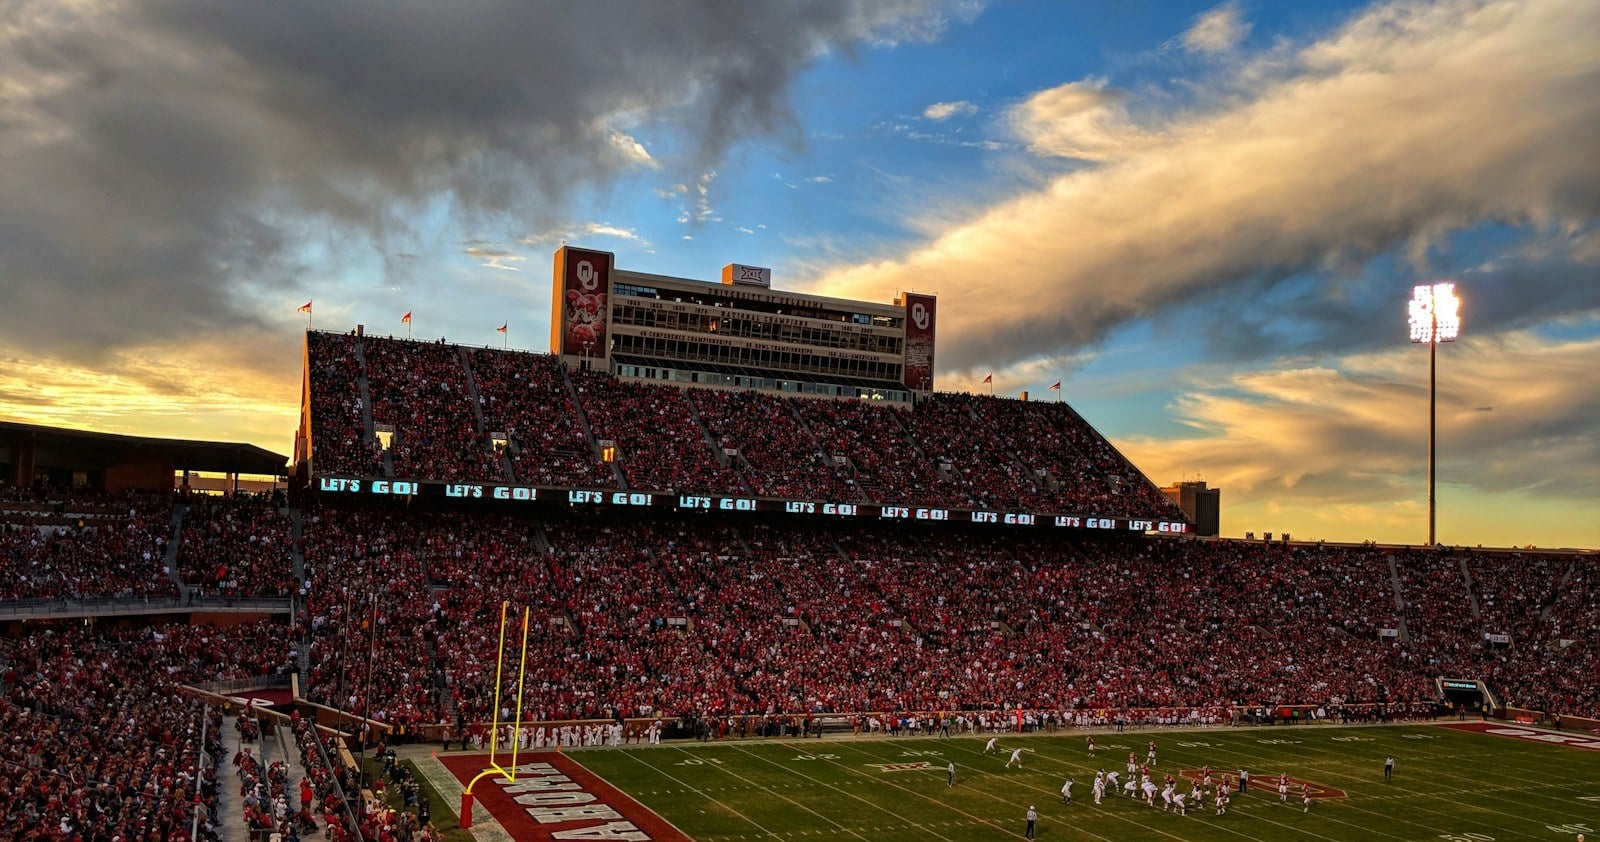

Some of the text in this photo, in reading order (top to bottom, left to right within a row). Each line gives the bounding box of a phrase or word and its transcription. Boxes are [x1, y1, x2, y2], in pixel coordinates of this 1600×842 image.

[577, 260, 599, 291] OU
[708, 288, 761, 300] UNIVERSITY
[721, 310, 760, 321] NATIONAL
[764, 316, 808, 327] CHAMPIONS
[321, 478, 1186, 533] LET'S GO! LET'S GO! LET'S GO! LET'S GO! LET'S GO! LET'S GO! LET'S GO! LET'S GO! LET'S GO!
